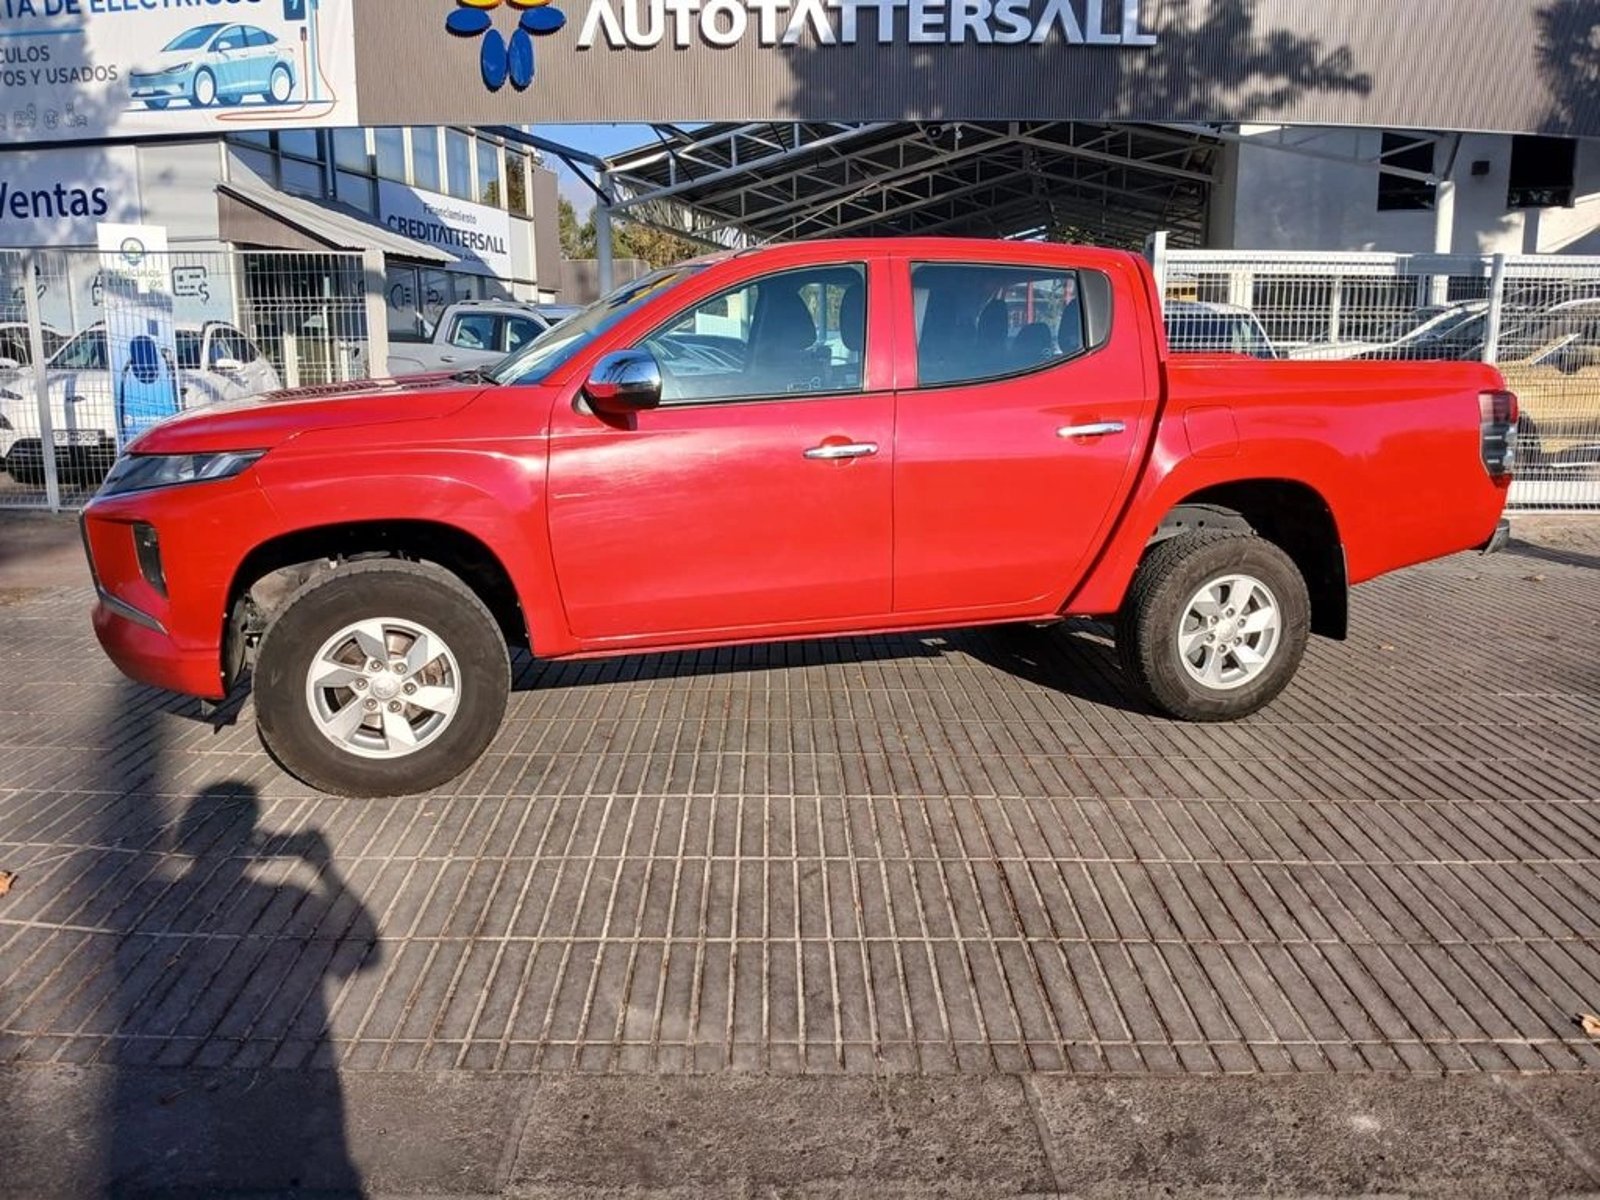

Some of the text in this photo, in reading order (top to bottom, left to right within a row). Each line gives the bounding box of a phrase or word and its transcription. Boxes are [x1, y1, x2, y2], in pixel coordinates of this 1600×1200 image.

[576, 0, 1157, 49] AUTOTATTERSALL
[31, 69, 42, 86] Y
[46, 65, 118, 83] USADOS
[387, 214, 507, 255] CREDITATTERSALL
